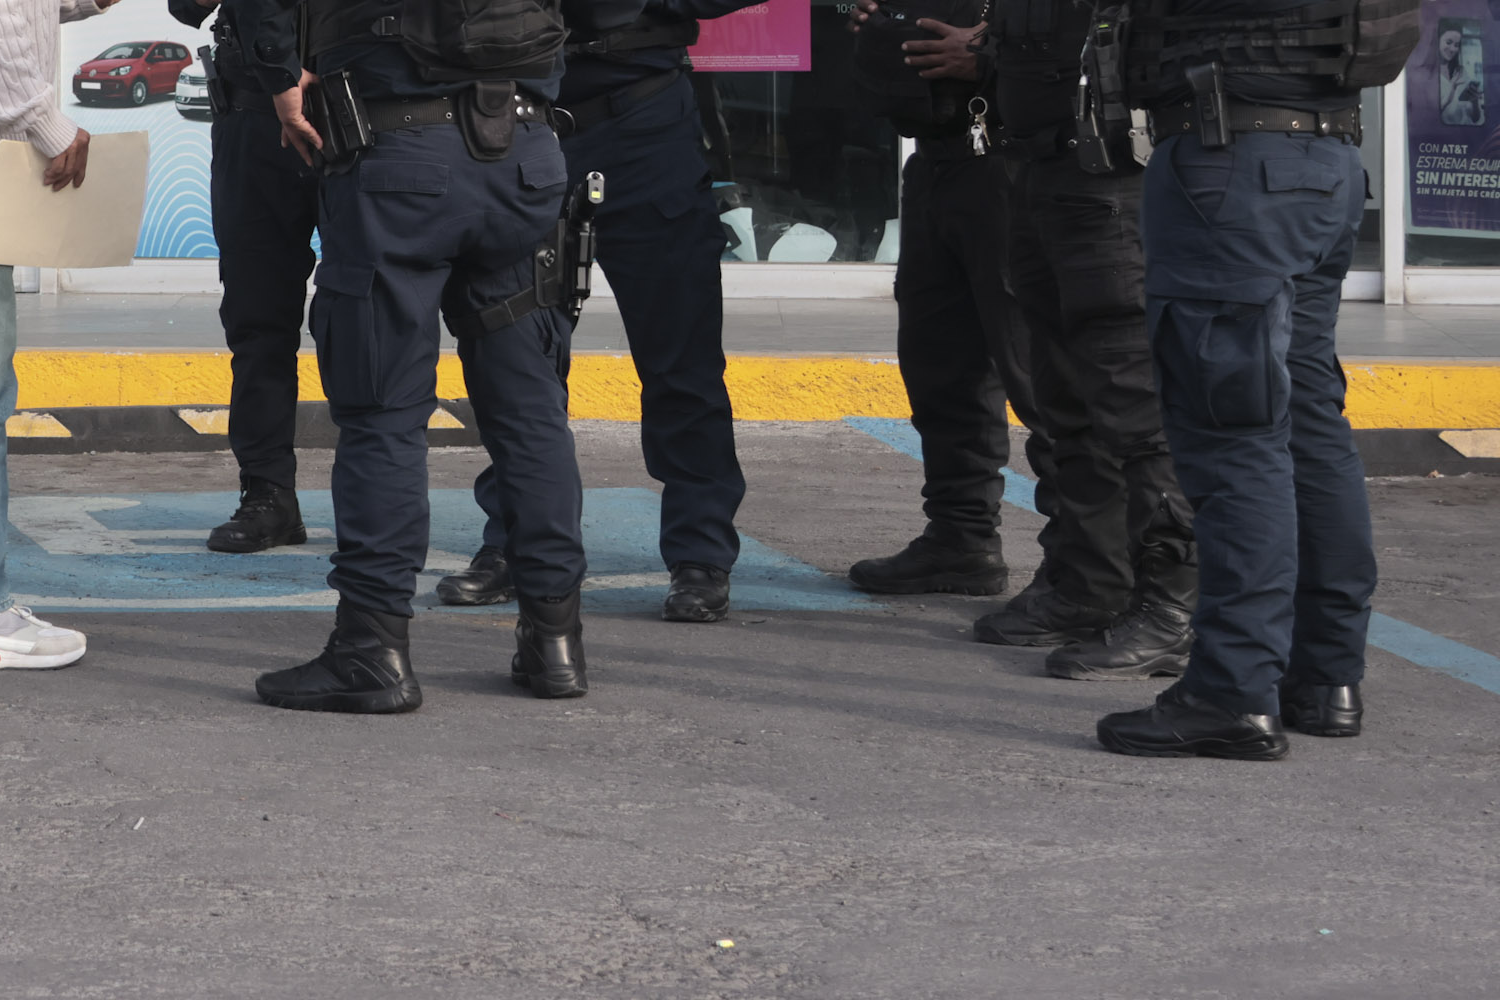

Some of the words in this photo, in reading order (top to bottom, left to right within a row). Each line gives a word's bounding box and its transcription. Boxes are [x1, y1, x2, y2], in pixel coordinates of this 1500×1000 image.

[1419, 143, 1439, 154] CON
[1441, 144, 1469, 155] AT&T
[1416, 155, 1467, 170] ESTRENA
[1415, 171, 1440, 185] SIN
[1441, 172, 1500, 188] INTERES
[1416, 187, 1430, 195] SIN
[1432, 188, 1466, 197] TARJETA
[1468, 190, 1478, 198] DE
